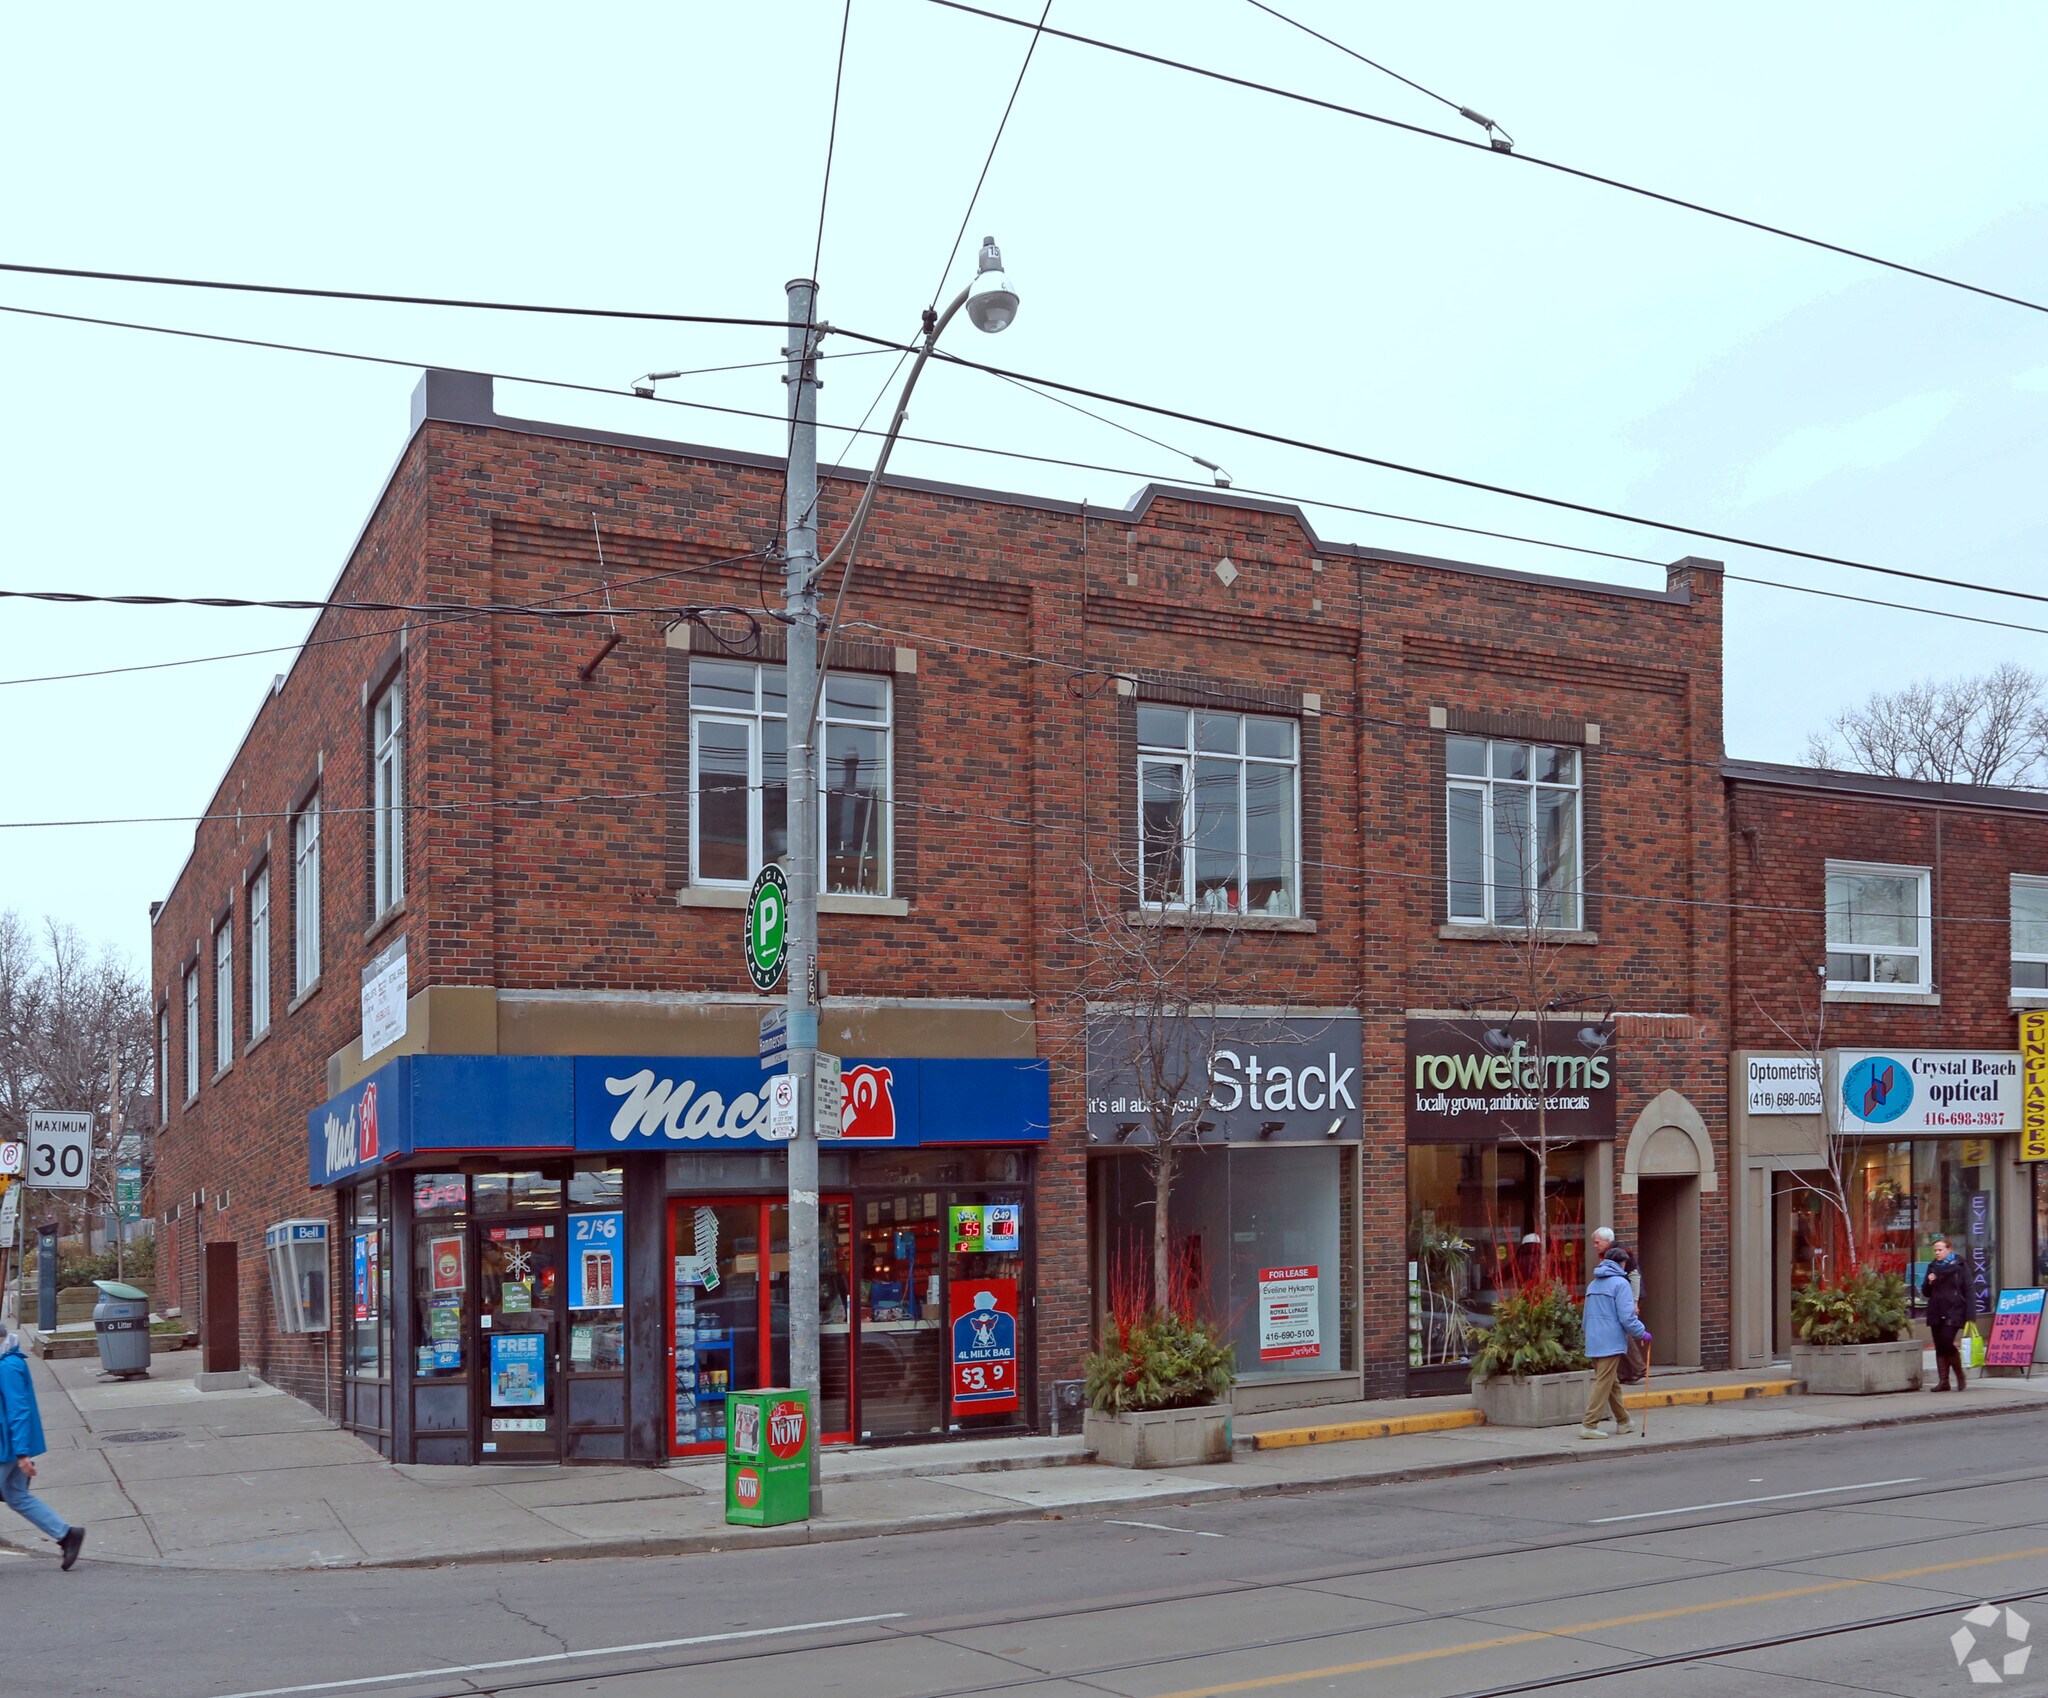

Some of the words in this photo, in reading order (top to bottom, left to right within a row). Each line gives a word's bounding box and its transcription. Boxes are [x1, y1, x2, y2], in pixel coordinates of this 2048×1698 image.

[1750, 1062, 1821, 1084] Optometrist
[1912, 1057, 1967, 1079] Crystal
[1971, 1058, 2016, 1076] Beach
[1206, 1049, 1356, 1112] Stack
[2025, 1014, 2046, 1156] SUNGLASSES
[1929, 1078, 1999, 1107] optical
[1088, 1097, 1107, 1113] it's
[1111, 1097, 1126, 1113] all
[1416, 1093, 1450, 1116] locally
[1451, 1097, 1488, 1115] grown,
[1490, 1093, 1557, 1111] antibiotic-ree
[1559, 1096, 1589, 1111] meats
[1750, 1093, 1774, 1109] (416)
[1777, 1093, 1821, 1106] 698-0054
[34, 1120, 87, 1133] MAXIMUM
[1923, 1112, 2005, 1126] 416-698-3937
[33, 1143, 84, 1178] 30
[419, 1186, 466, 1208] OPEN
[1972, 1196, 1985, 1235] EYE
[299, 1227, 318, 1238] Bell
[1268, 1270, 1285, 1279] FOR
[1285, 1268, 1308, 1278] LEASE
[1973, 1247, 1989, 1312] EXAMS
[1263, 1286, 1287, 1295] Eveline
[1288, 1284, 1315, 1294] Hykamp
[2000, 1298, 2016, 1310] Eye
[2016, 1290, 2045, 1305] Exam?
[117, 1321, 132, 1329] Litter
[1996, 1314, 2010, 1326] LET
[2010, 1314, 2021, 1326] US
[2021, 1314, 2037, 1326] PAY
[574, 1330, 590, 1338] PASS
[1265, 1329, 1315, 1341] 416-690-5100
[2000, 1330, 2015, 1341] FOR
[2015, 1329, 2024, 1341] IT
[497, 1338, 537, 1352] FREE
[958, 1351, 969, 1359] 4L
[970, 1349, 991, 1359] MILK
[992, 1347, 1011, 1357] BAG
[770, 1418, 802, 1446] NOW
[738, 1480, 758, 1498] NOW
